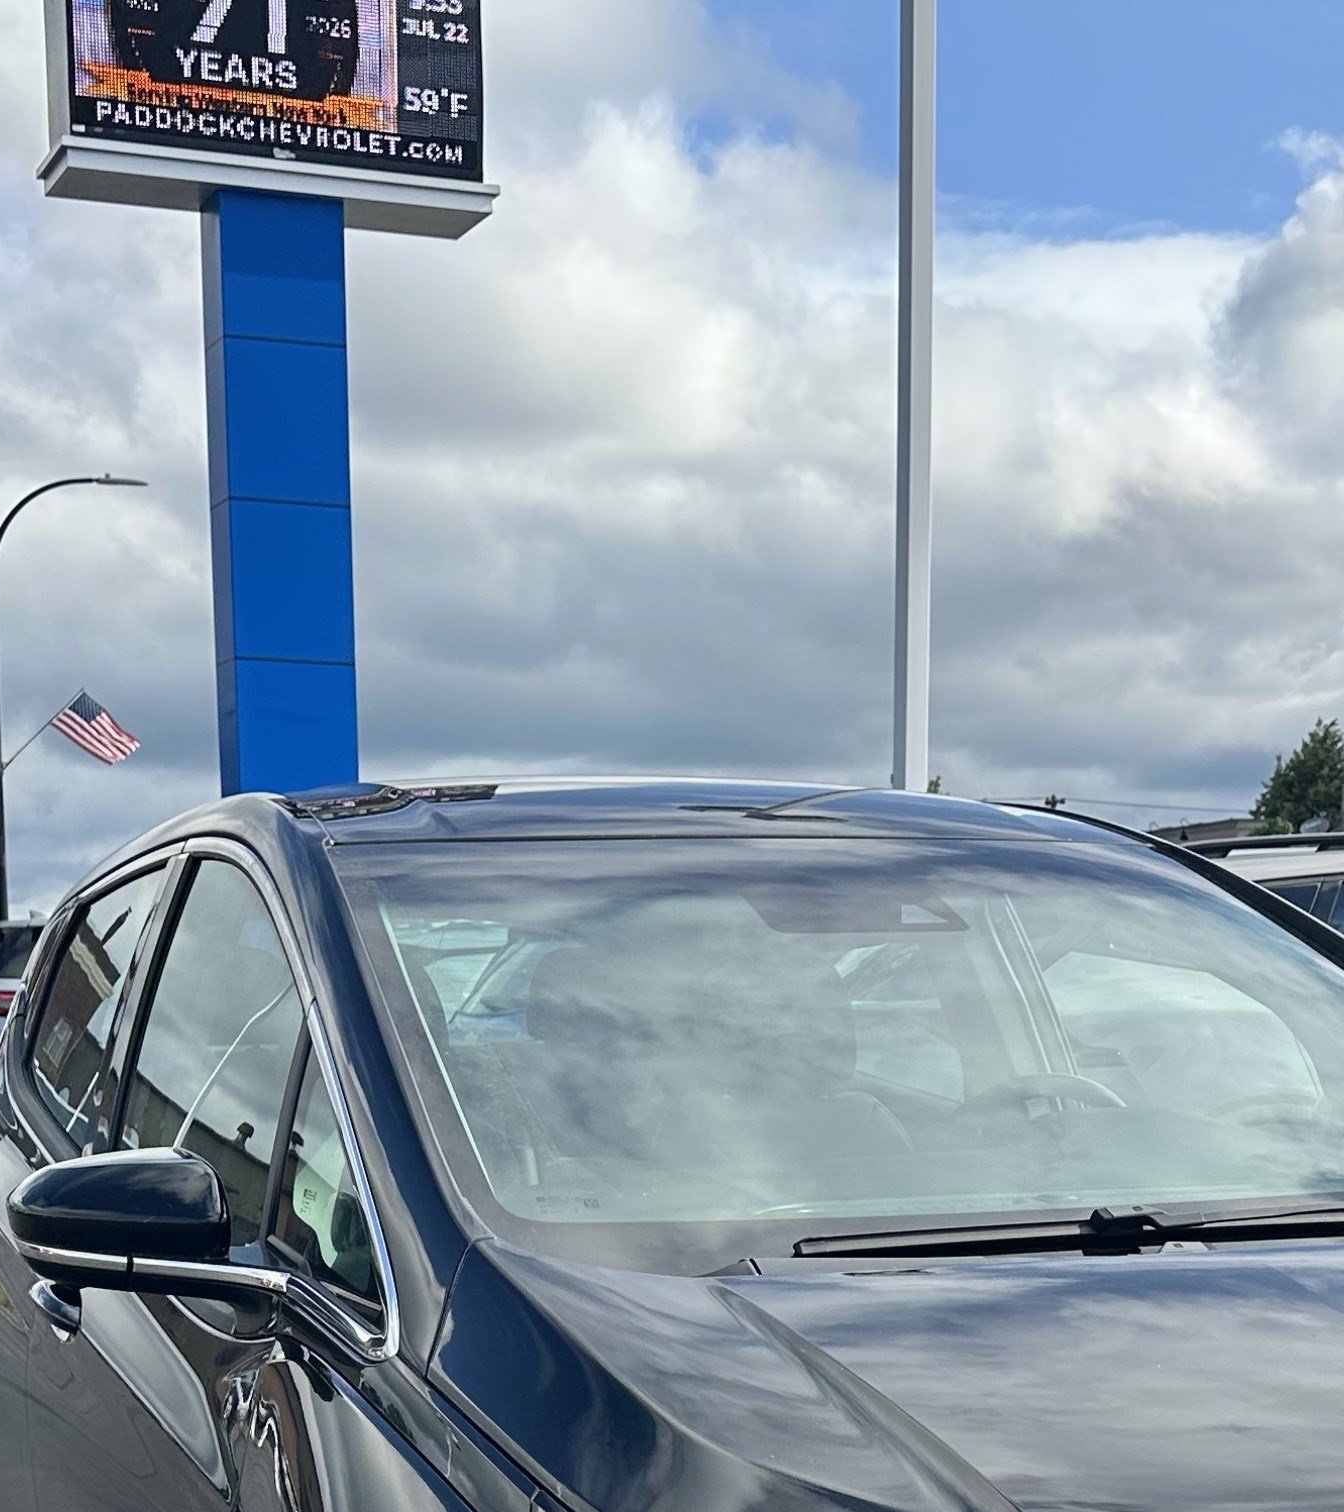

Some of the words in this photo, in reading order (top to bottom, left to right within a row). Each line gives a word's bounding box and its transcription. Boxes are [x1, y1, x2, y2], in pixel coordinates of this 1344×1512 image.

[402, 17, 441, 40] JUL
[443, 22, 470, 44] 22
[175, 46, 297, 90] YEARS
[96, 100, 463, 165] PADDOCKCHEVROLET.COM
